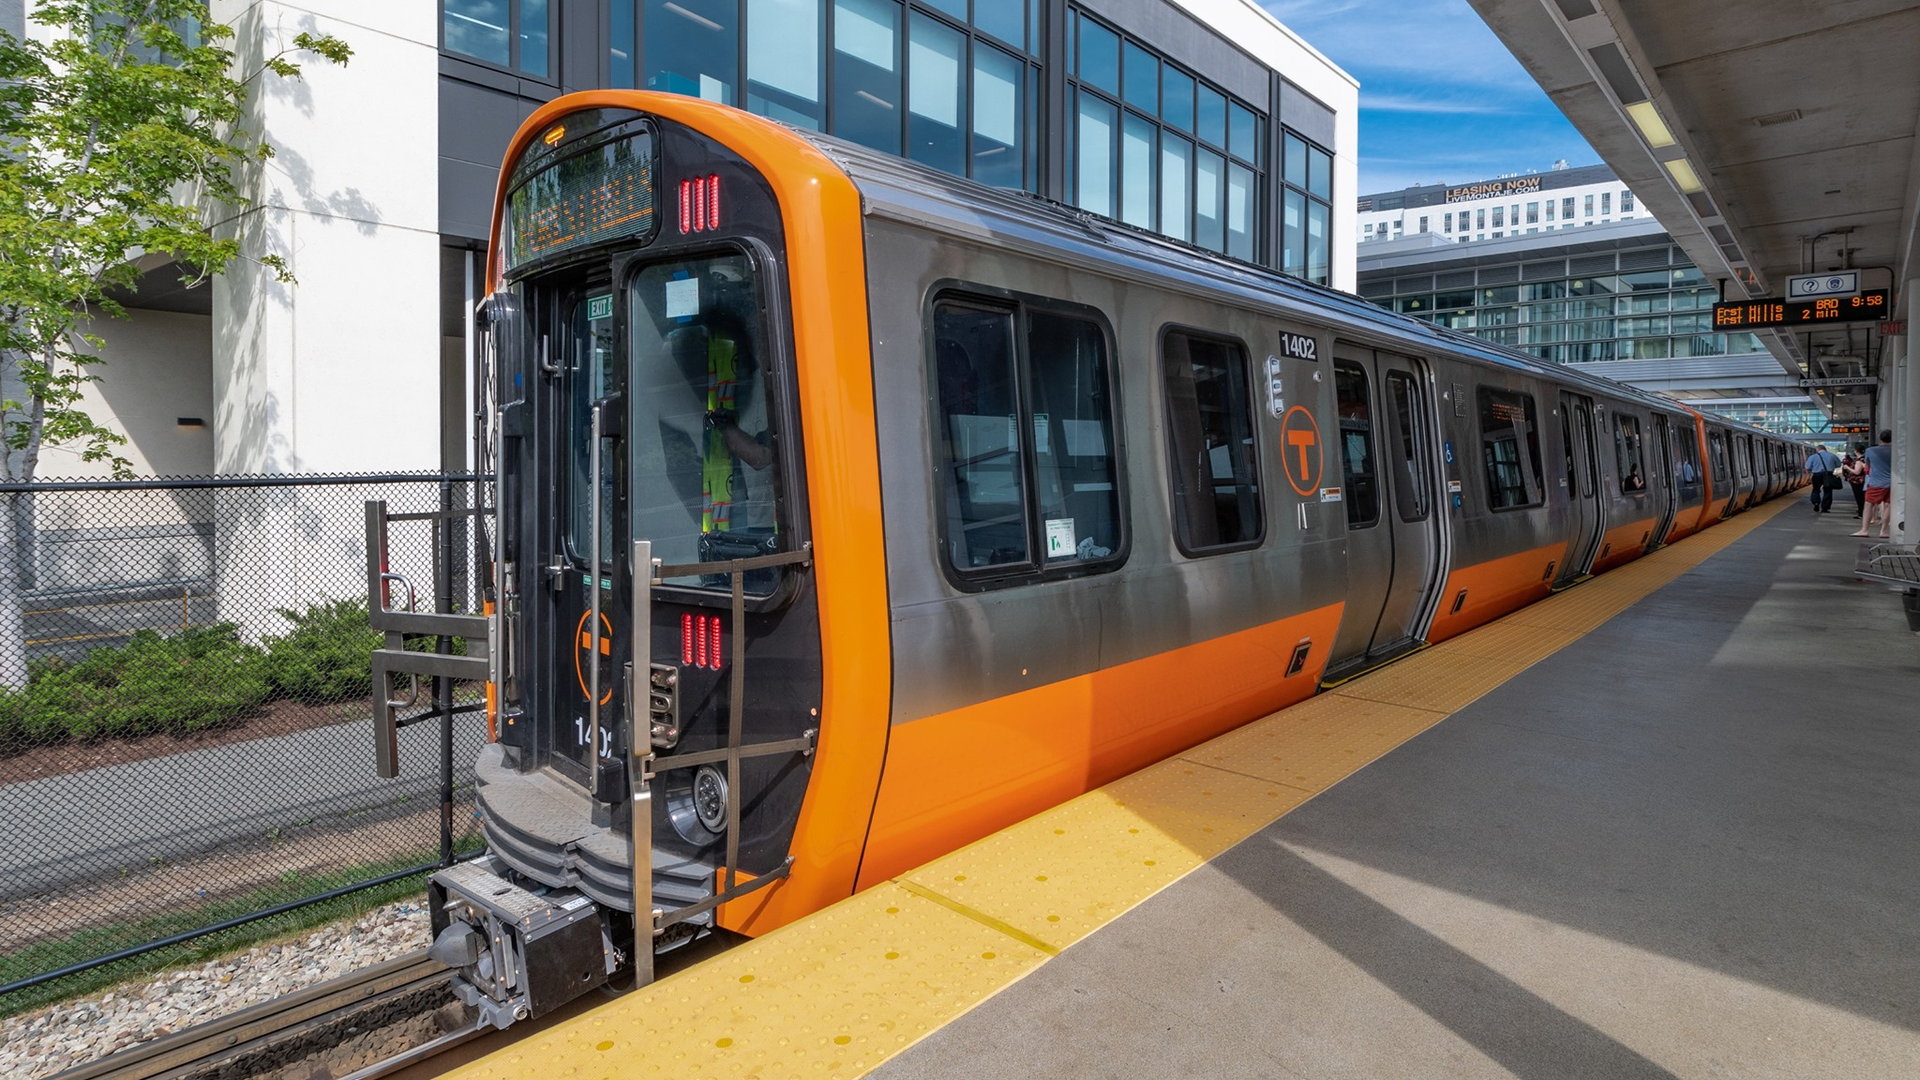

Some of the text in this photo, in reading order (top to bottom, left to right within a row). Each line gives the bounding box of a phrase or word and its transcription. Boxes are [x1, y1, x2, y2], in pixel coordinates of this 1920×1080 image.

[1446, 177, 1540, 198] LEASING NOW
[1446, 186, 1540, 203] LIVEMONTAJE.COM
[591, 299, 607, 317] EXIT
[1749, 304, 1783, 314] Hills
[1816, 298, 1838, 310] BRD
[1852, 295, 1882, 307] 9:58
[1749, 313, 1783, 323] Hills
[1802, 309, 1811, 319] 2
[1816, 308, 1838, 318] min
[1880, 321, 1902, 335] EXIT
[1281, 333, 1316, 359] 1402
[1287, 430, 1315, 481] T
